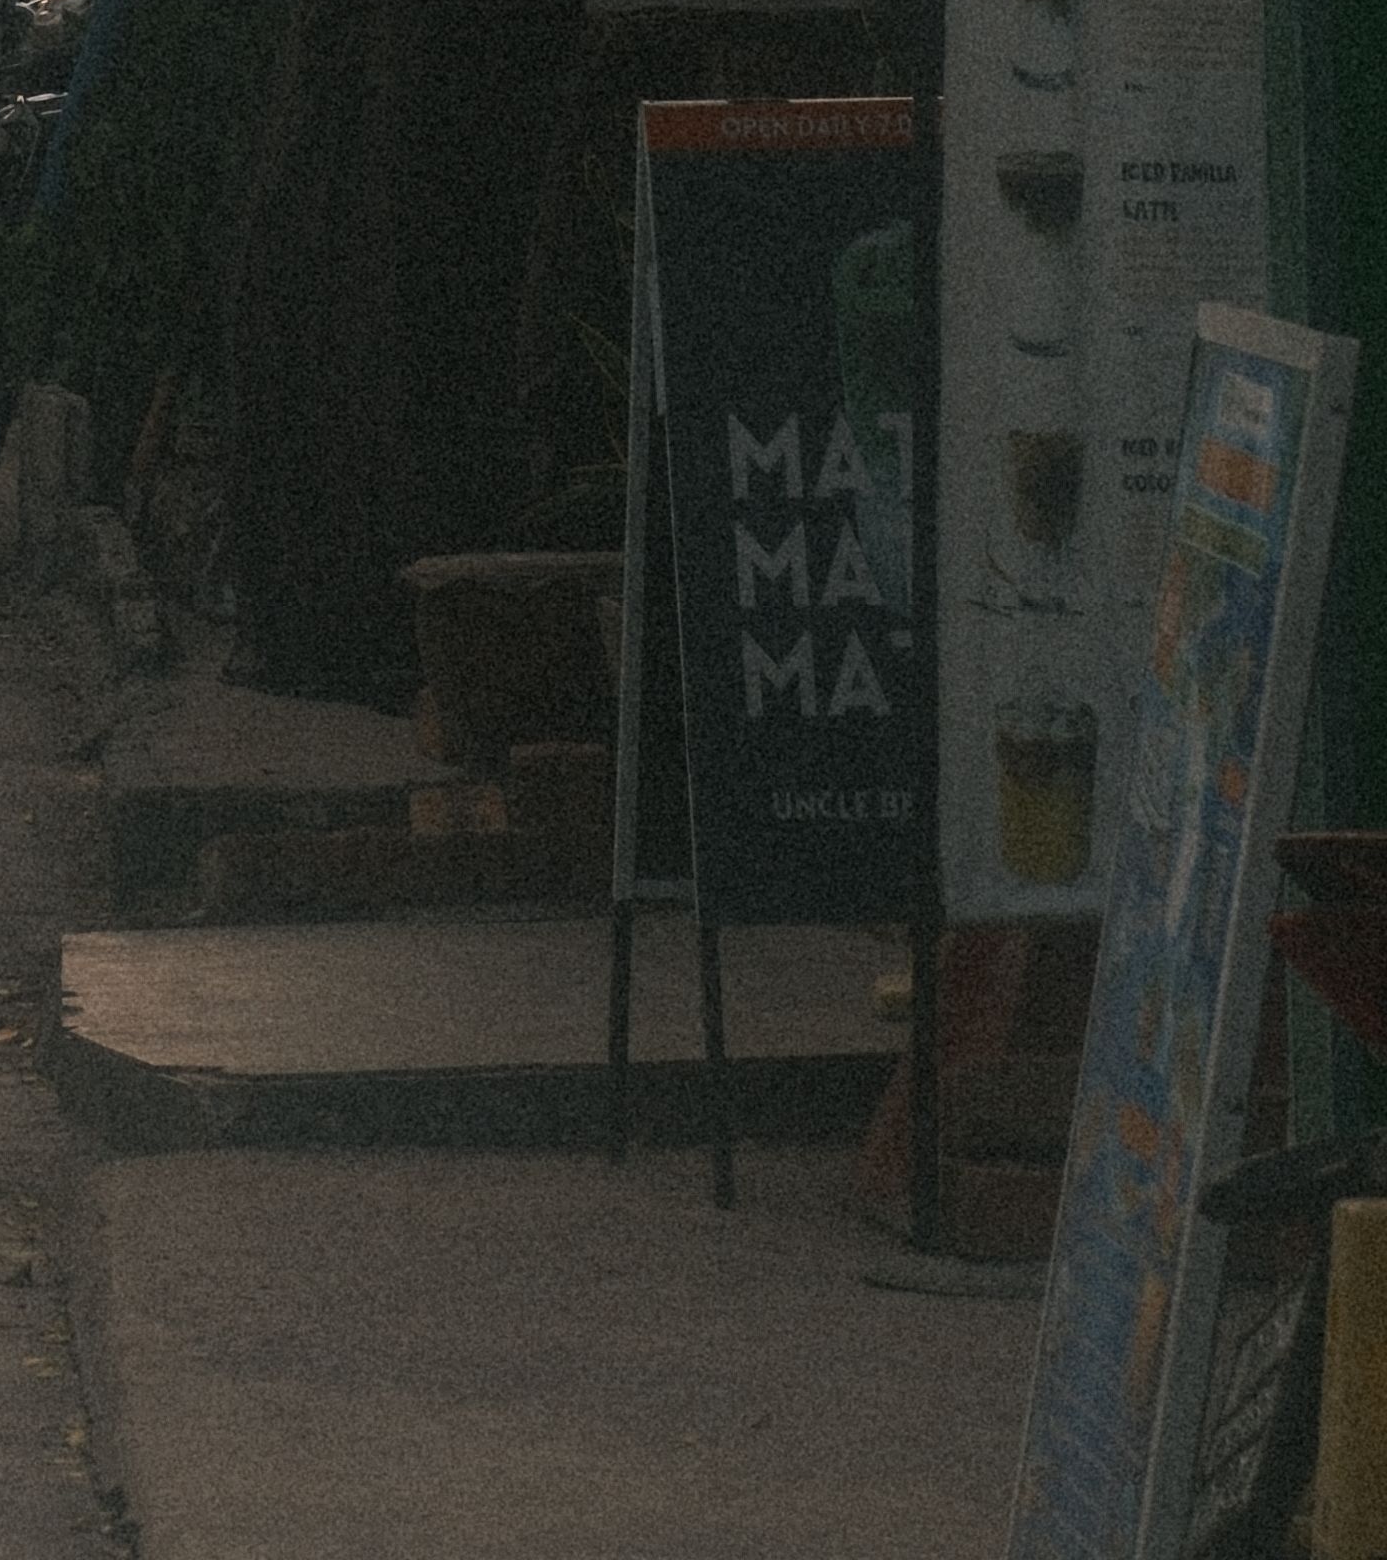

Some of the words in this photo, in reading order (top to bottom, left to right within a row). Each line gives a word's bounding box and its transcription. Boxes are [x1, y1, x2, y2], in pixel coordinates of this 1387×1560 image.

[721, 116, 788, 139] OPEN
[797, 113, 872, 137] DAILY
[1121, 162, 1165, 183] ICED
[734, 520, 913, 608] MA
[772, 791, 868, 821] UNCLE
